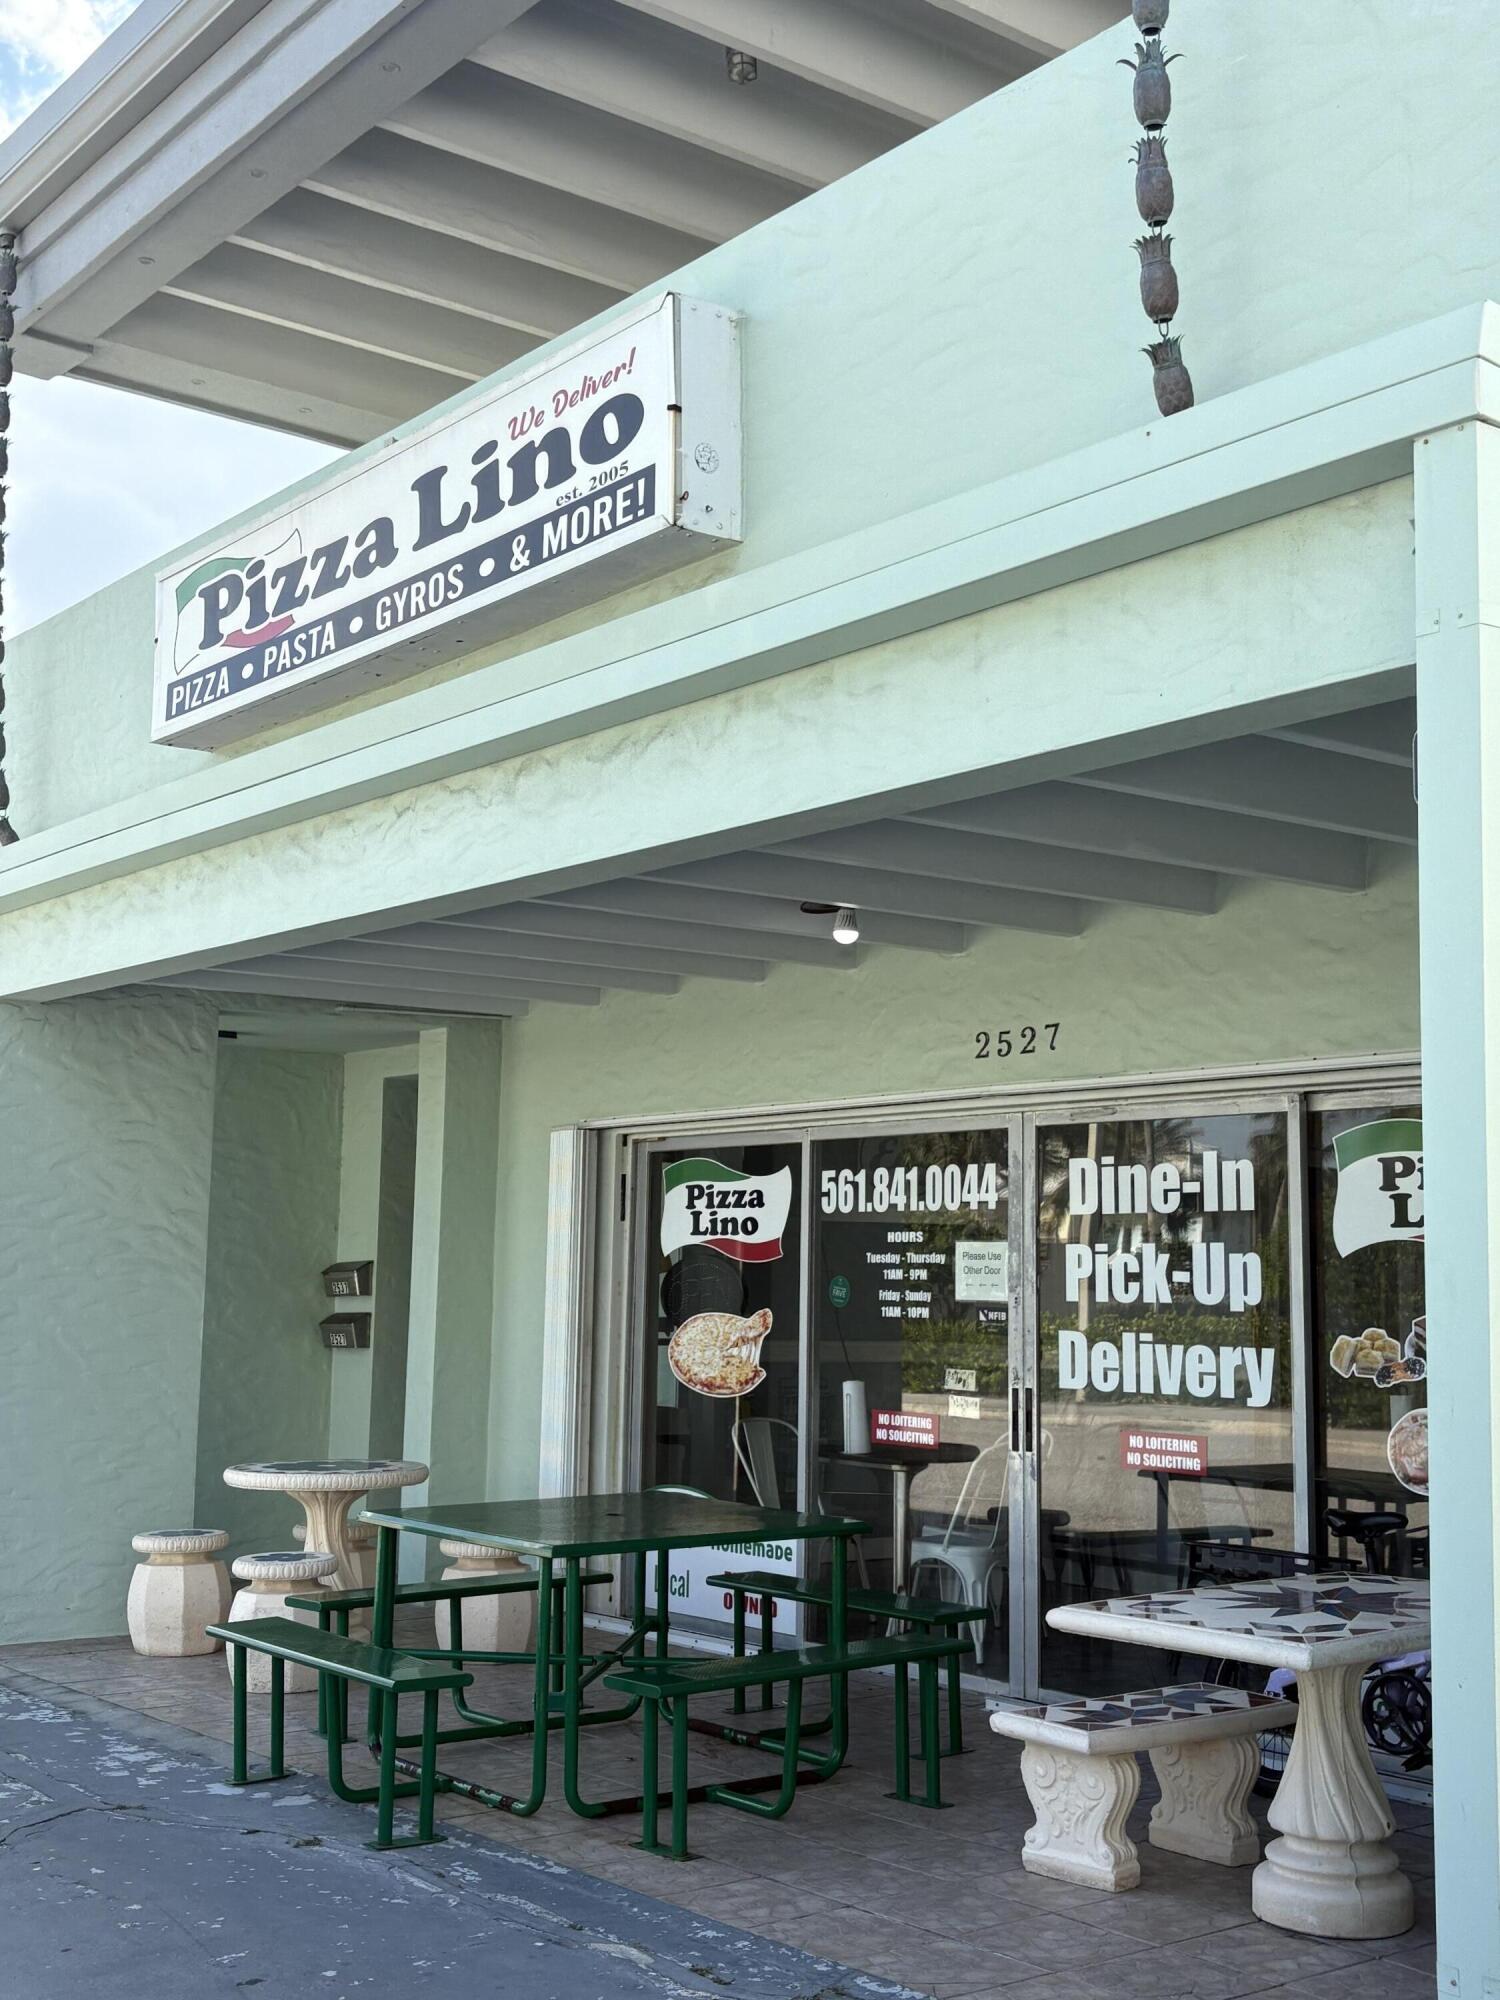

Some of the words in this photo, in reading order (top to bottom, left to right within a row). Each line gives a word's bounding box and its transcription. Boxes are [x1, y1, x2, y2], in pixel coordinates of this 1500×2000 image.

[508, 405, 545, 440] We
[552, 347, 636, 417] Deliver!
[555, 486, 583, 507] est.
[588, 460, 629, 492] 2005
[198, 516, 399, 650] Pizza
[410, 392, 645, 552] Lino
[171, 666, 230, 717] PIZZA
[263, 620, 336, 679] PASTA
[375, 563, 464, 631] GYROS
[509, 534, 531, 573] &
[541, 477, 646, 559] MORE!
[974, 1022, 1061, 1059] 2527
[820, 1163, 999, 1214] 561.841.0044
[1068, 1150, 1255, 1216] Dine-In
[685, 1184, 765, 1210] Pizza
[689, 1211, 759, 1236] Lino
[887, 1231, 924, 1243] HOURS
[866, 1252, 901, 1265] Tuesday
[906, 1252, 946, 1265] Thursday
[962, 1251, 986, 1261] Please
[987, 1251, 1002, 1261] Use
[883, 1269, 903, 1280] 11AM
[909, 1269, 928, 1280] 9PM
[963, 1265, 983, 1275] Other
[983, 1265, 1001, 1275] Door
[1065, 1242, 1262, 1312] Pick-Up
[879, 1290, 901, 1302] Friday
[904, 1290, 932, 1303] Sunday
[881, 1306, 901, 1318] 11AM
[907, 1307, 929, 1319] 10PM
[1058, 1330, 1275, 1407] Delivery
[878, 1413, 890, 1426] NO
[891, 1414, 932, 1429] LOITERING
[876, 1428, 887, 1440] NO
[888, 1429, 934, 1445] SOLICITING
[1129, 1435, 1144, 1449] NO
[1145, 1436, 1198, 1453] LOITERING
[1126, 1452, 1141, 1466] NO
[1142, 1453, 1201, 1471] SOLICITING
